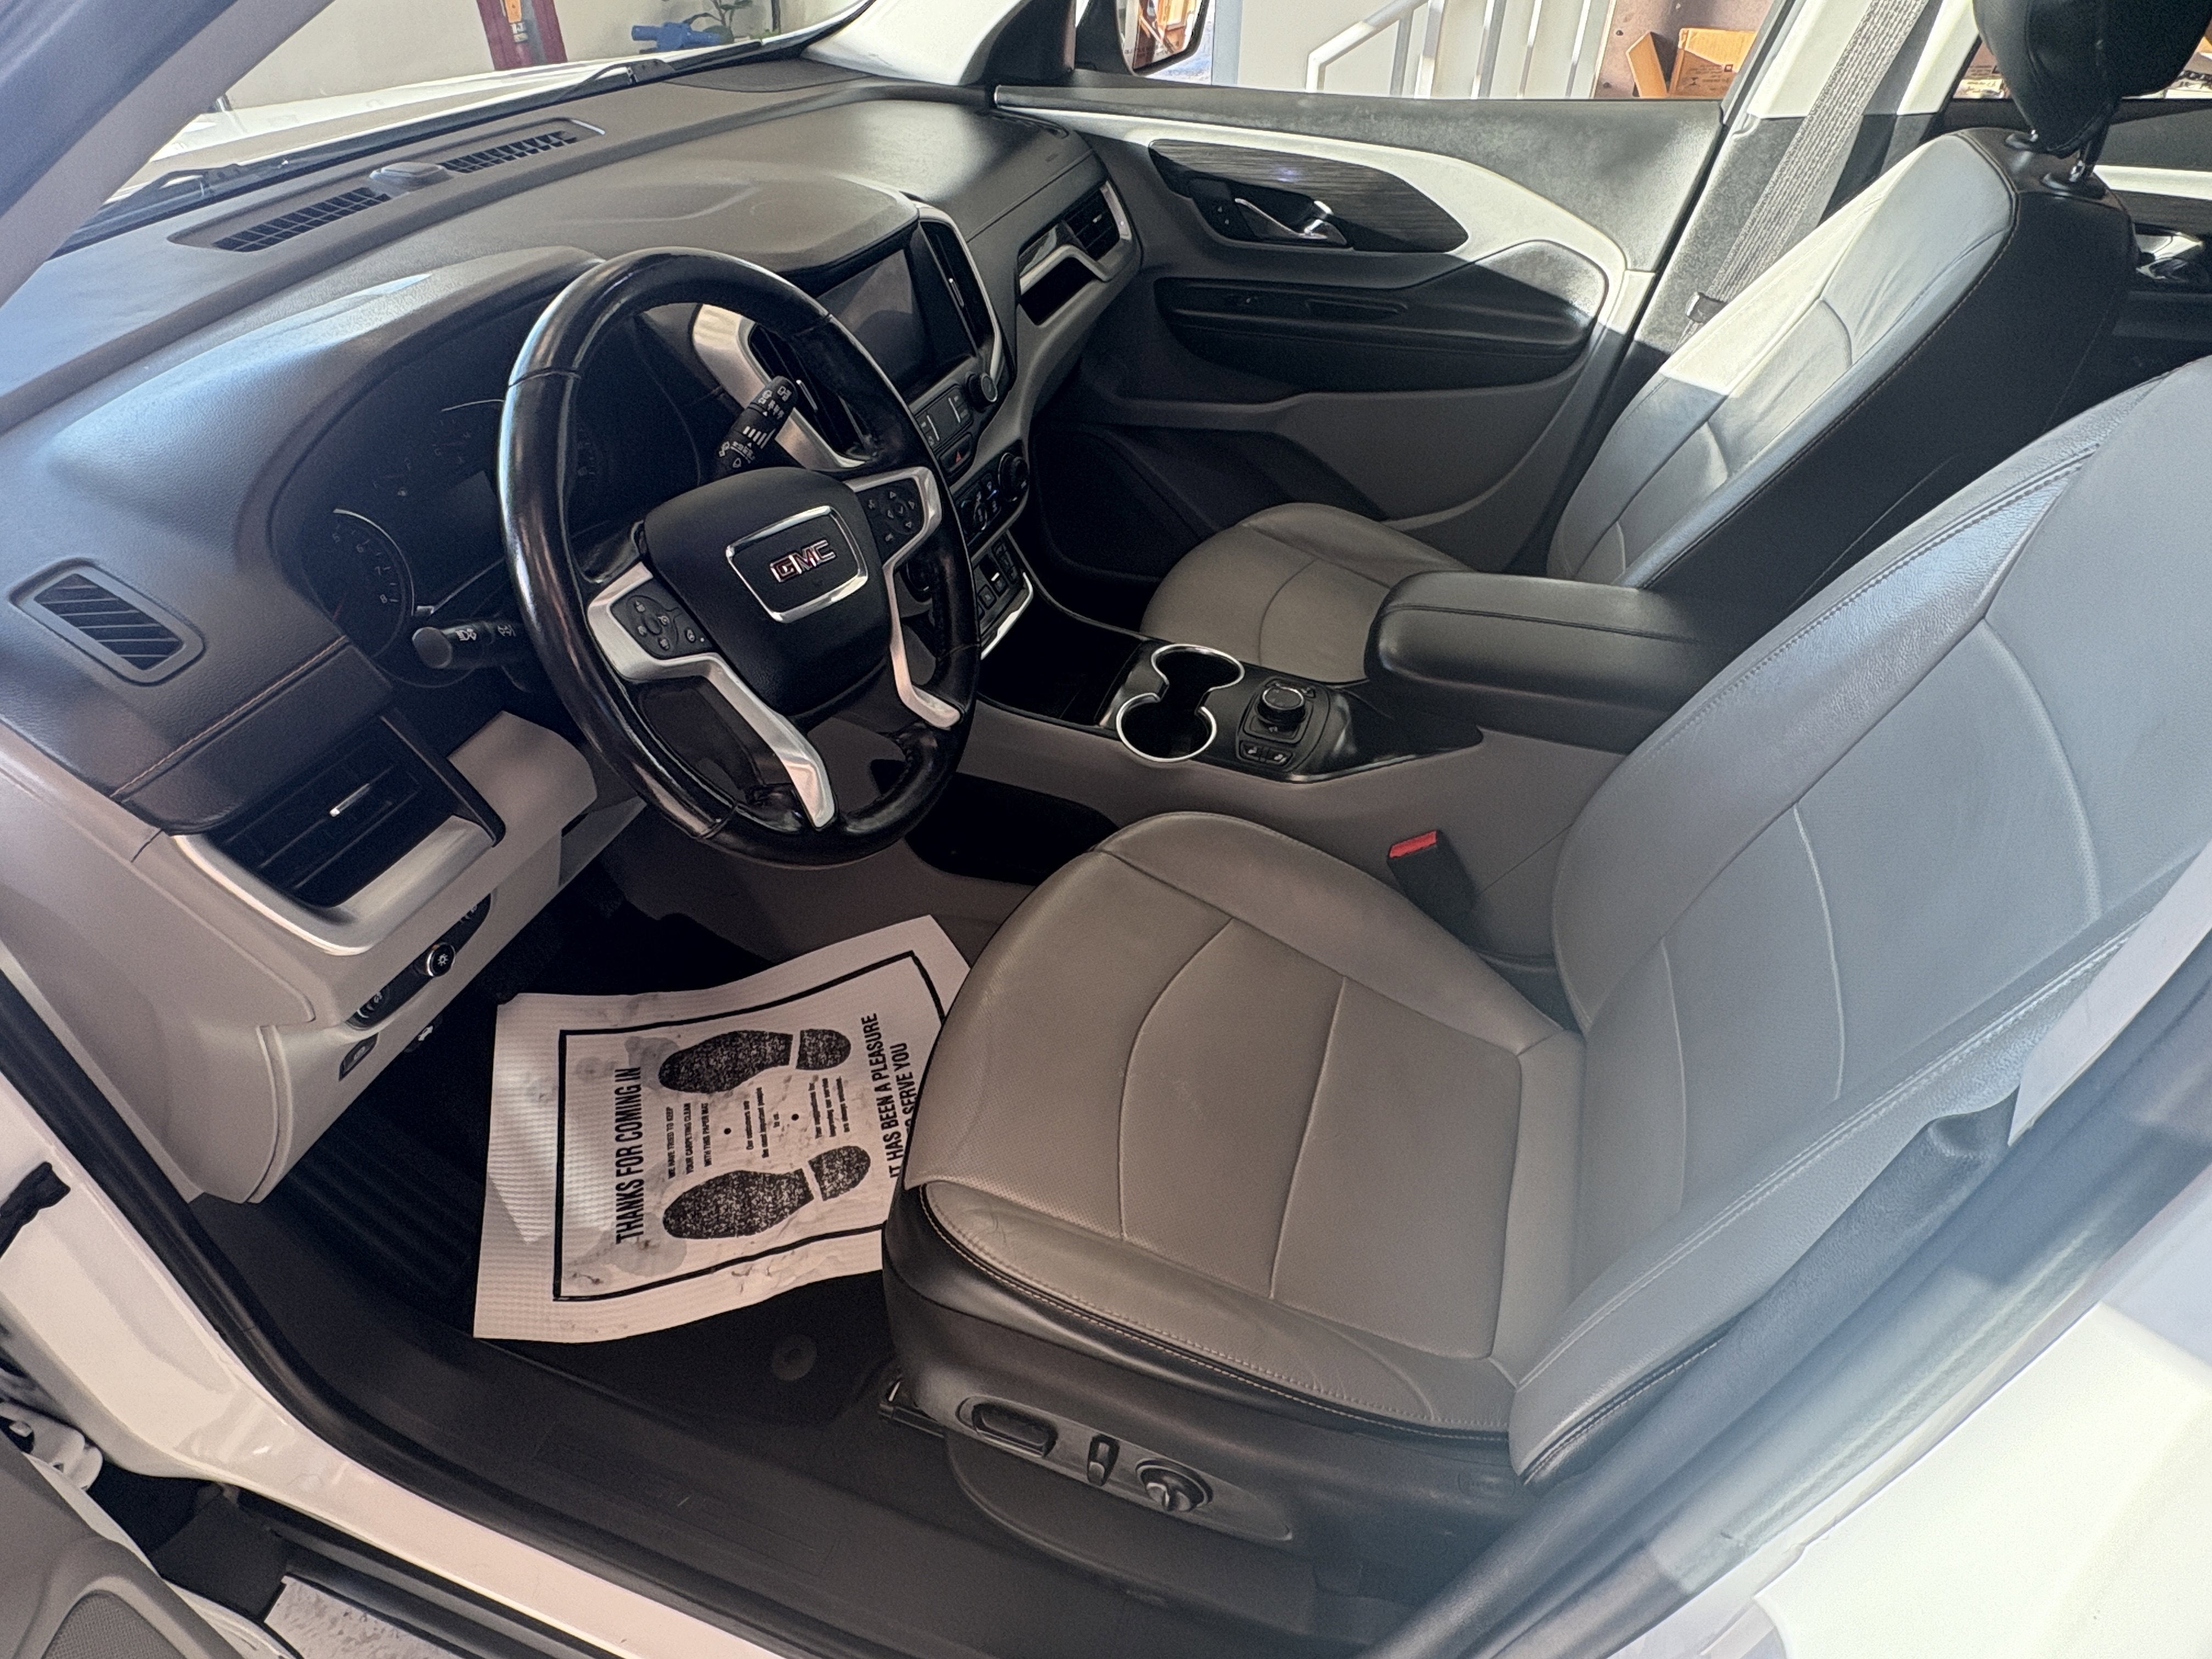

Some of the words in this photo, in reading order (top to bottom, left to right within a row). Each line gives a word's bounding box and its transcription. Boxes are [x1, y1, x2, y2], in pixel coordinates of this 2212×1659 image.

[770, 539, 837, 583] GMC
[861, 1013, 889, 1081] PLEASURE
[890, 1042, 911, 1071] YOU
[614, 1066, 641, 1081] IN
[874, 1082, 891, 1092] A
[896, 1072, 917, 1114] SERVE
[614, 1084, 643, 1142] COMING
[876, 1095, 899, 1130] BEEN
[615, 1144, 644, 1177] FOR
[883, 1131, 904, 1160] HAS
[889, 1165, 901, 1177] IT
[616, 1179, 644, 1244] THANKS
